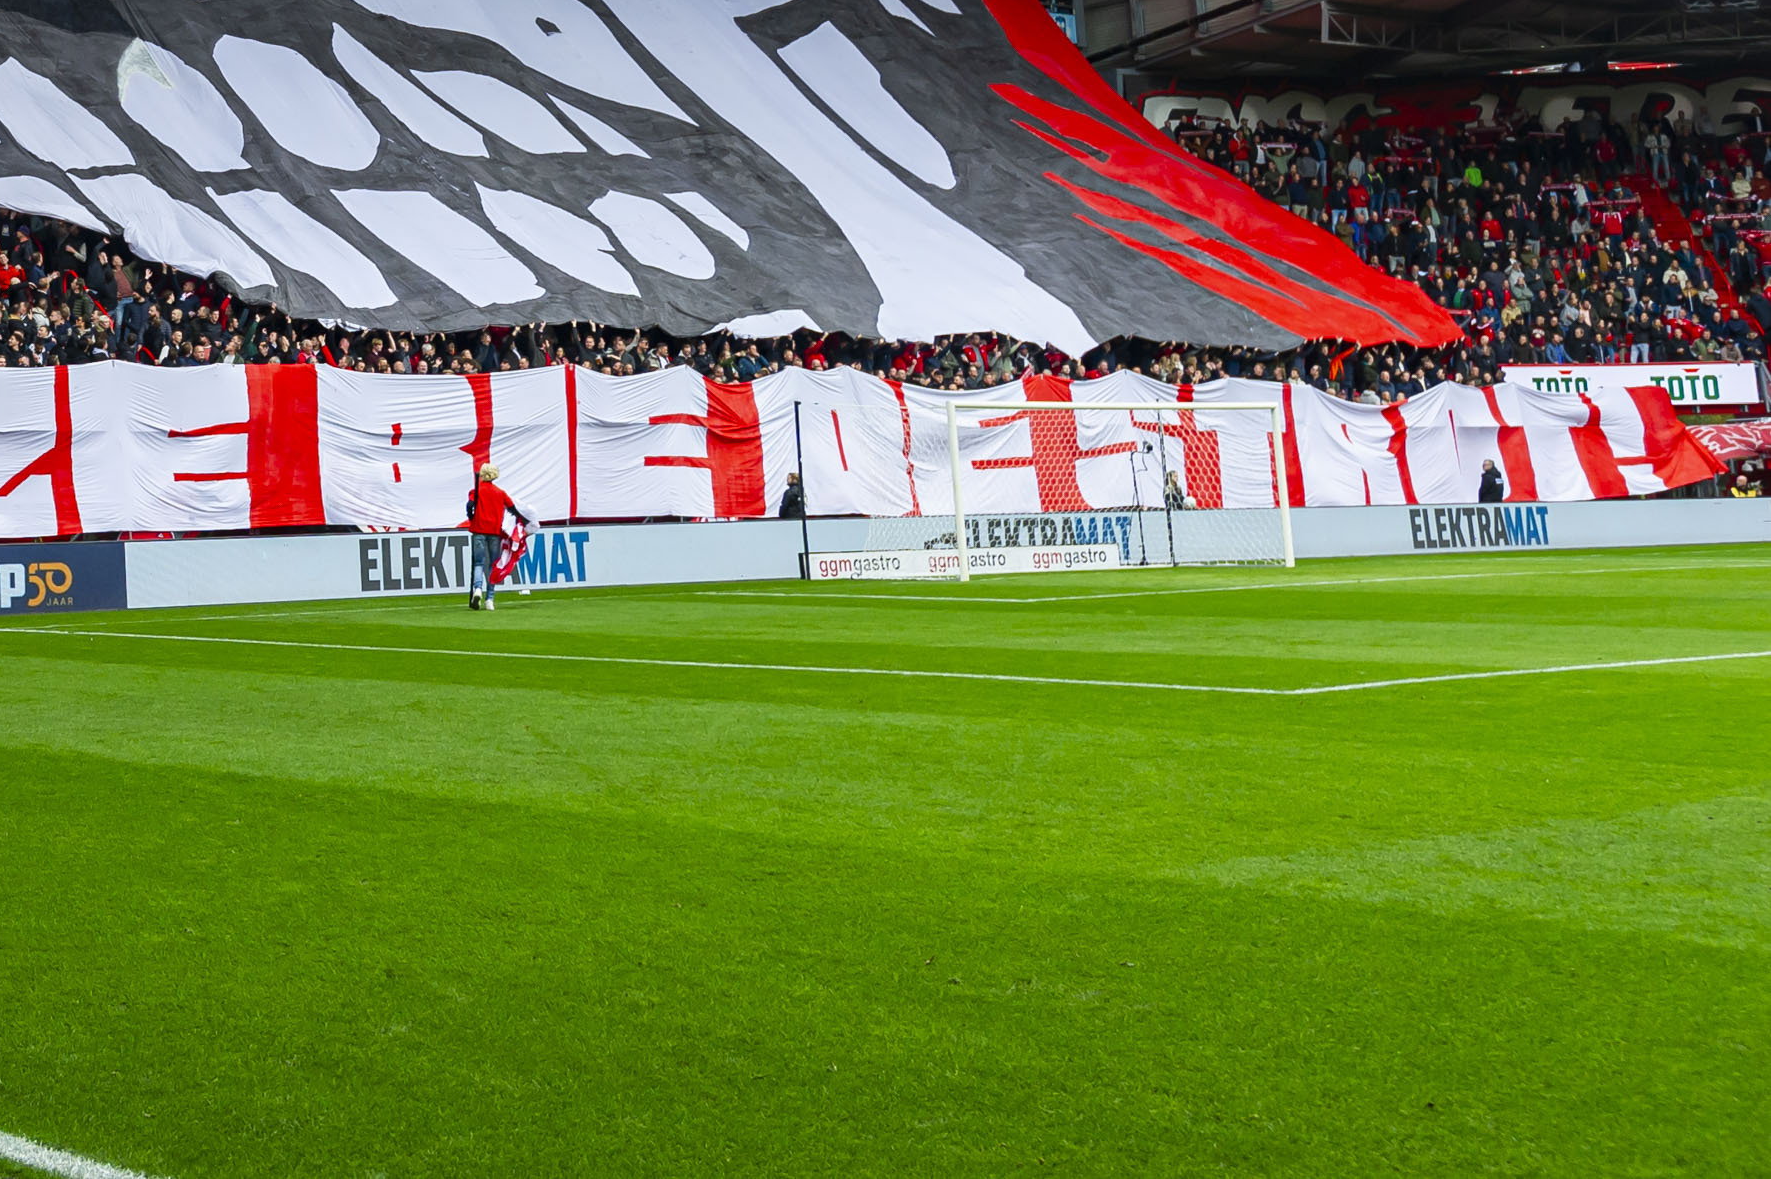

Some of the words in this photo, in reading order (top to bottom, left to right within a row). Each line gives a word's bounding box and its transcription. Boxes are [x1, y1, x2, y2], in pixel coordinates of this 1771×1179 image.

[1409, 506, 1549, 549] ELEKTRAMAT
[359, 531, 589, 591] ELEKTMAT
[929, 551, 1006, 573] ggmastro
[28, 561, 72, 607] 50
[46, 596, 74, 606] JAAR
